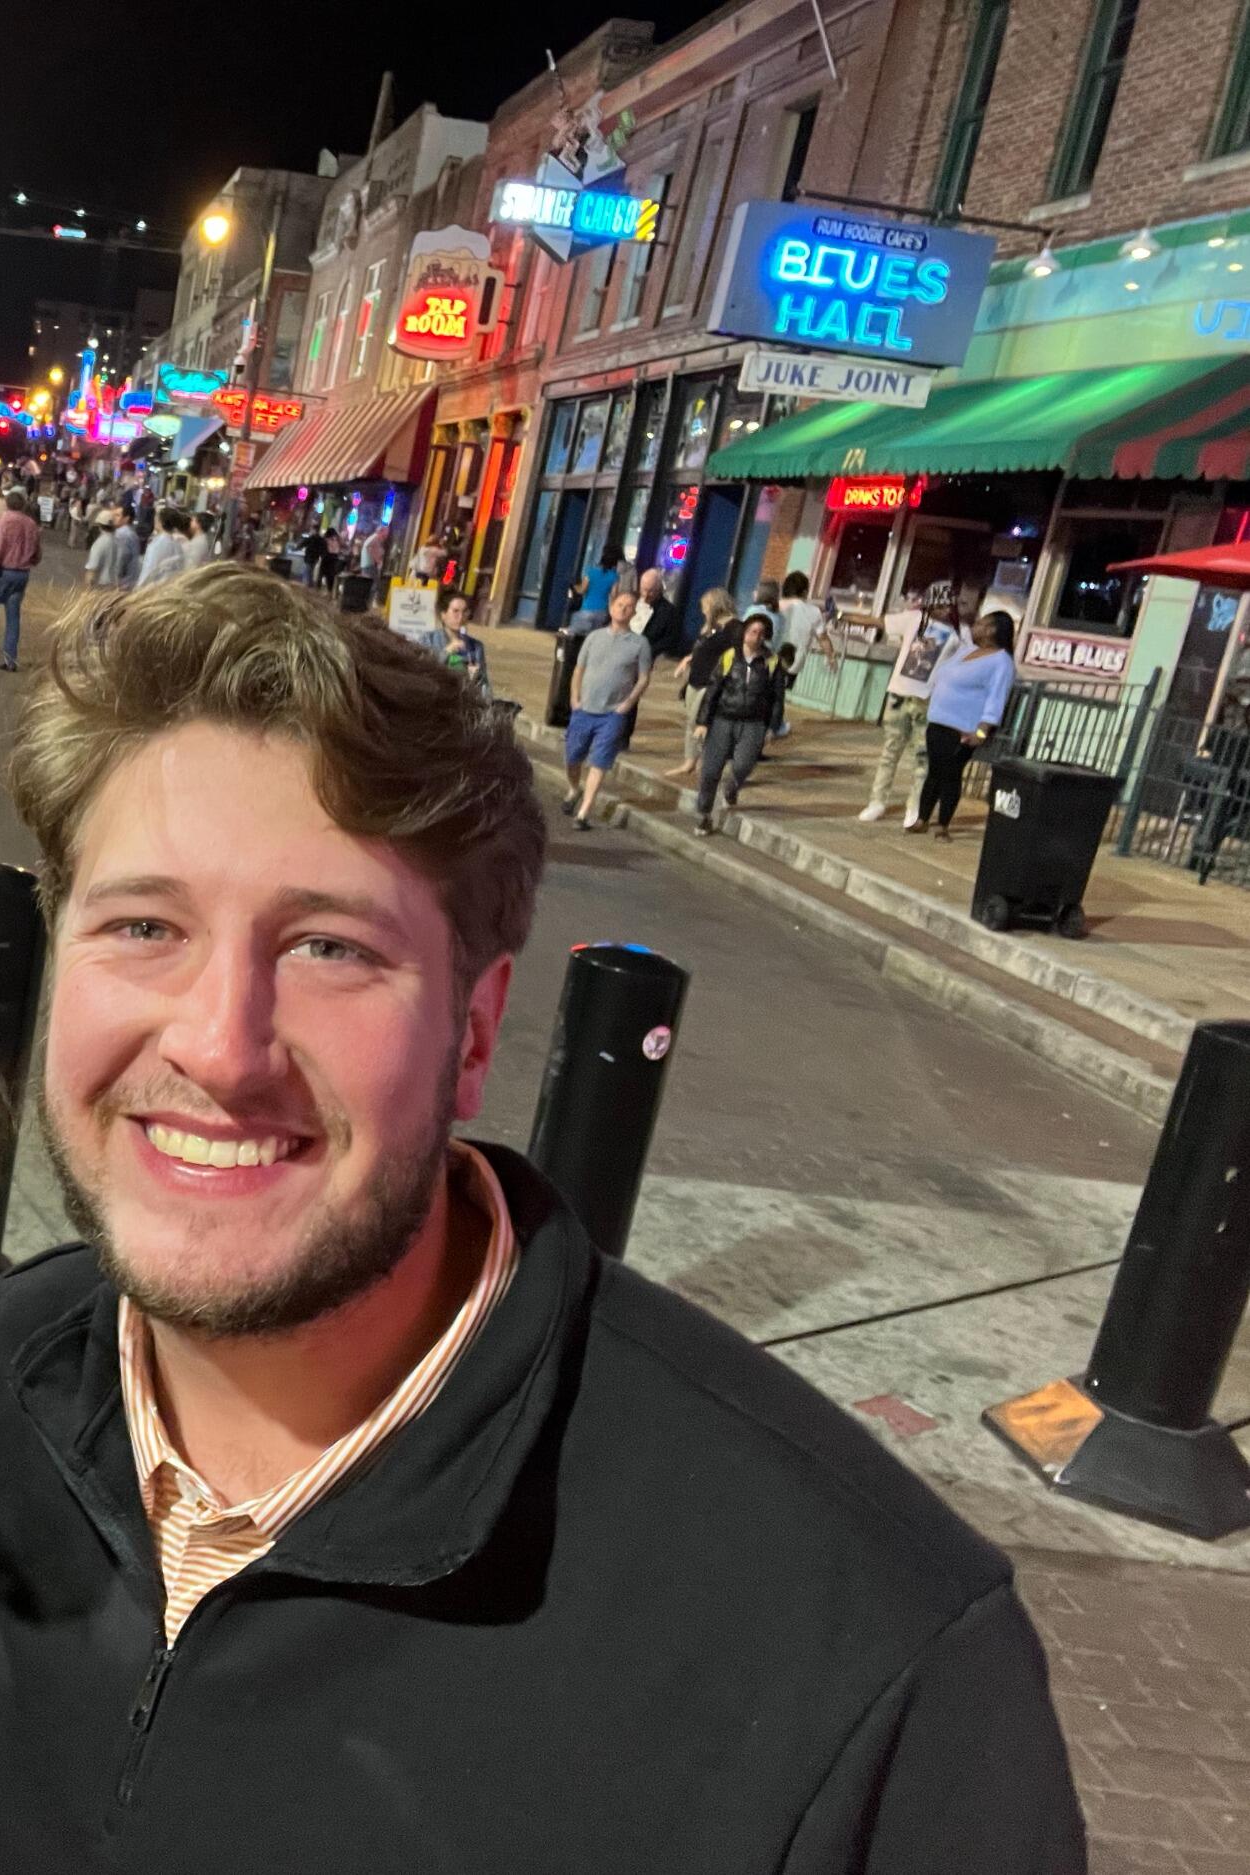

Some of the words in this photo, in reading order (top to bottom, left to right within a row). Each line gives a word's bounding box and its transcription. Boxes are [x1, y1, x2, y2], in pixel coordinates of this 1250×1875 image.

[500, 183, 575, 227] STRANGE
[580, 195, 639, 234] CARGO
[817, 218, 843, 237] RUM
[843, 223, 885, 244] BOOGIE
[778, 240, 950, 304] BLUES
[425, 297, 467, 315] TAP
[775, 294, 912, 351] HALL
[405, 314, 466, 337] ROOM
[757, 361, 824, 387] JUKE
[838, 369, 915, 396] JOINT
[844, 488, 880, 506] DRINKS
[882, 487, 896, 506] TO
[1030, 639, 1072, 663] DELTA
[1073, 643, 1127, 672] BLUES
